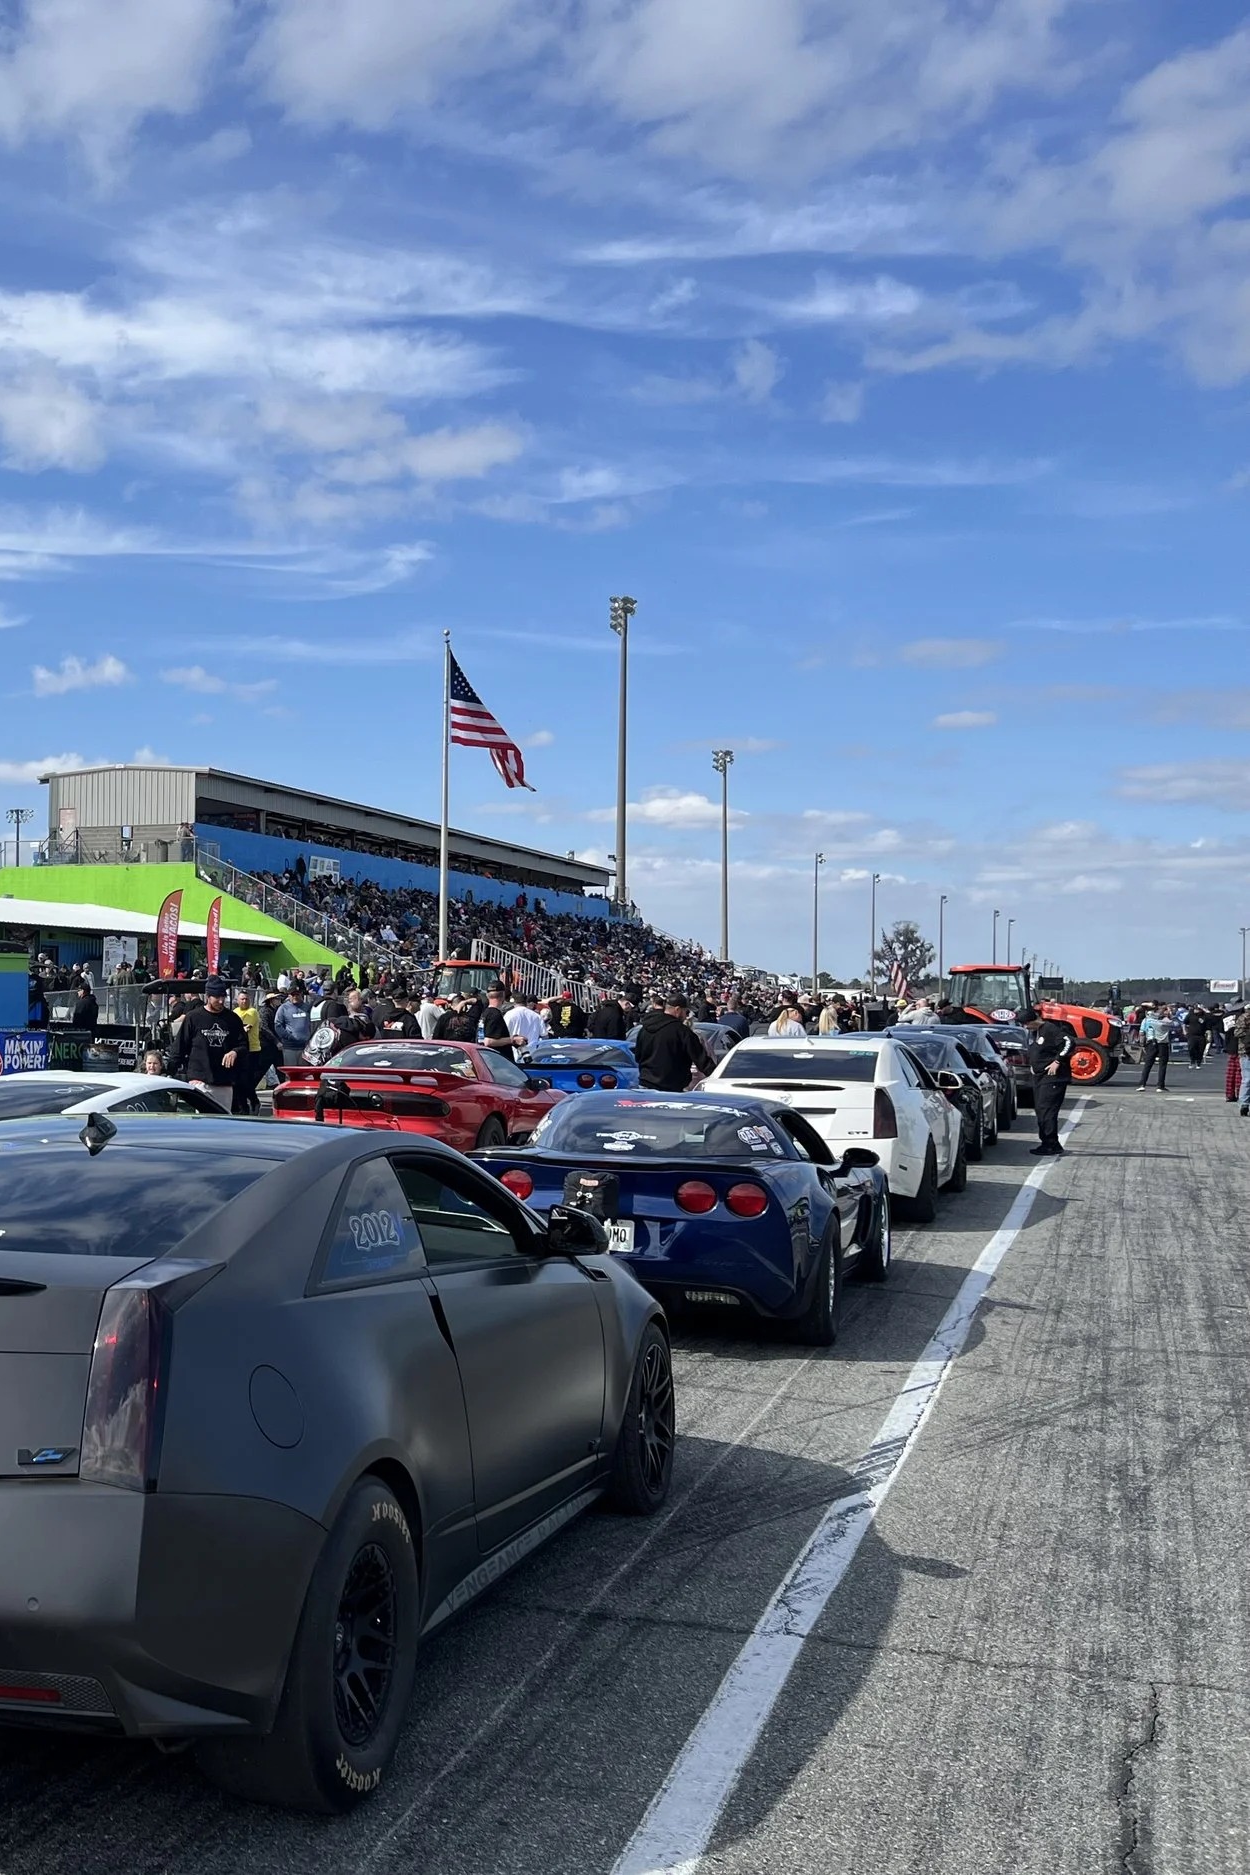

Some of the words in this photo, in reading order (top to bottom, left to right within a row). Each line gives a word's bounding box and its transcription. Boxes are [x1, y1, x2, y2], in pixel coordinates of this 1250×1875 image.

[169, 902, 179, 938] TACOS!
[4, 1055, 46, 1069] POWER!
[349, 1210, 400, 1251] 2012
[608, 1229, 627, 1243] MO
[446, 1534, 533, 1612] VENGEANCE
